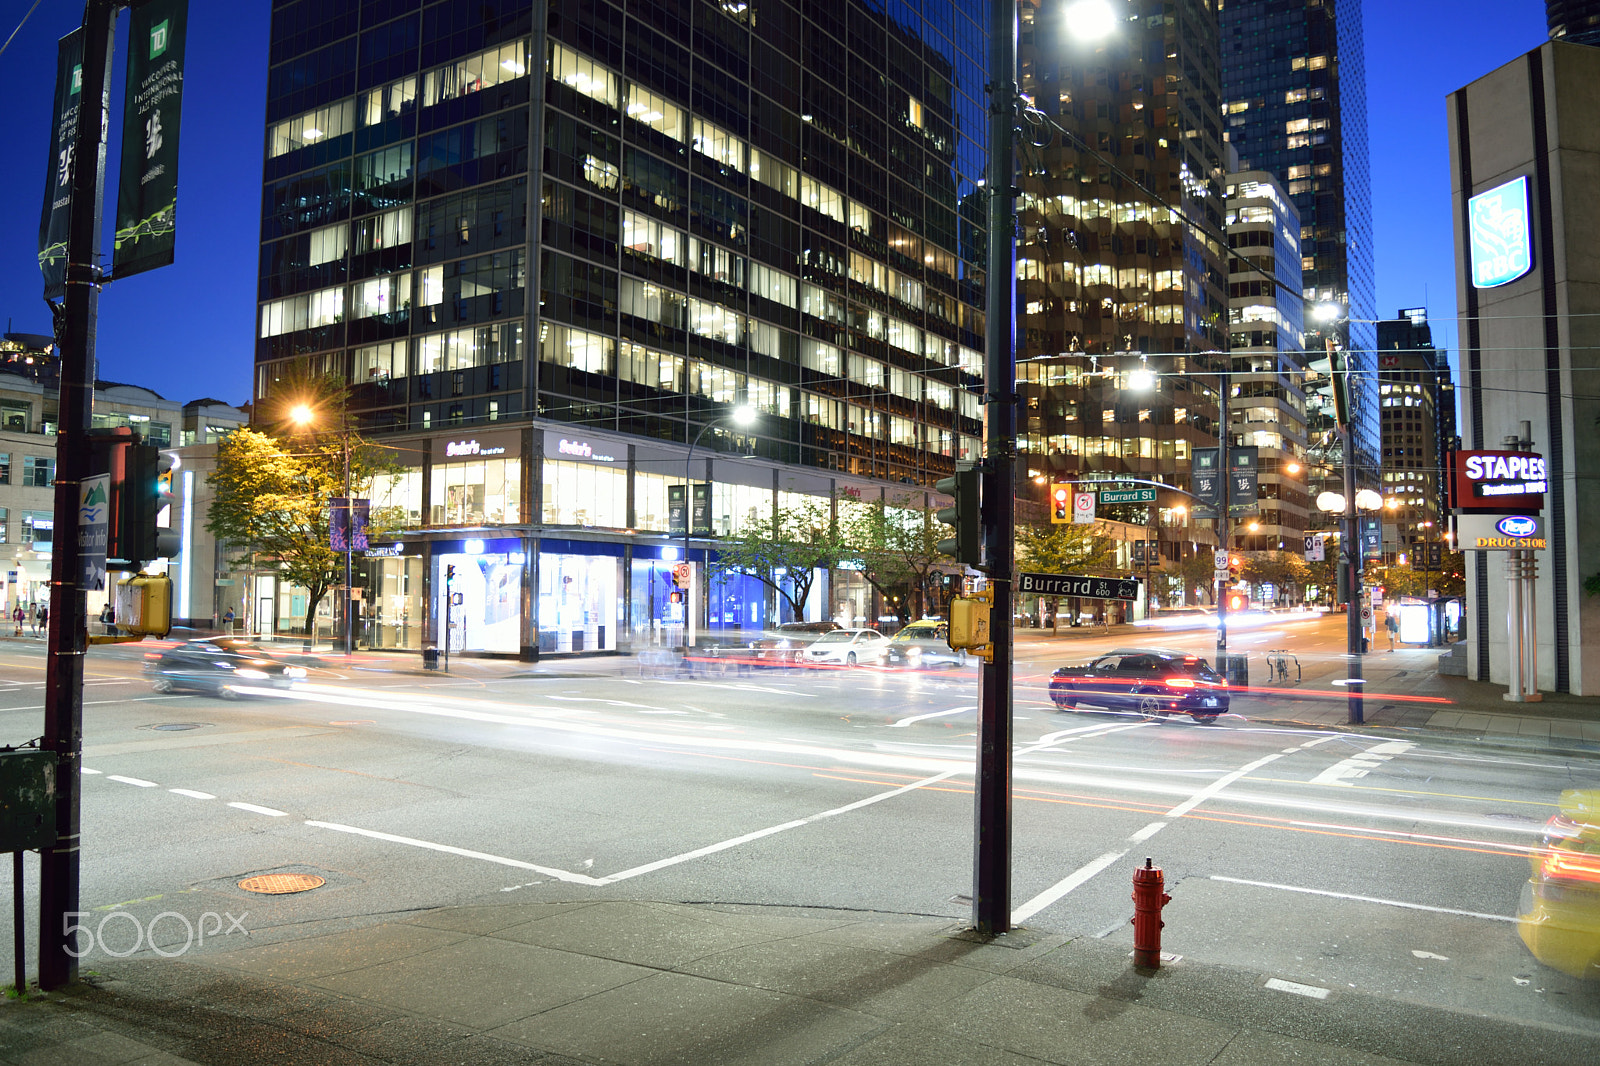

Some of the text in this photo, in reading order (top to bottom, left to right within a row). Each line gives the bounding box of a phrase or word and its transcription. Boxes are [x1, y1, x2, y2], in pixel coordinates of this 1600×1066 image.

[151, 27, 166, 52] TD
[141, 60, 178, 89] VANCOUVER
[134, 71, 184, 104] INTERNATIONAL
[138, 84, 180, 115] JAZZ FESTIVAL
[1477, 249, 1525, 284] RBC
[1465, 455, 1546, 480] STAPLES
[1103, 490, 1153, 502] Burrard St
[1476, 537, 1547, 549] DRUG STORE
[1216, 556, 1227, 565] 99
[1023, 576, 1091, 595] Burrard
[1099, 581, 1108, 590] St
[1095, 588, 1110, 596] 600
